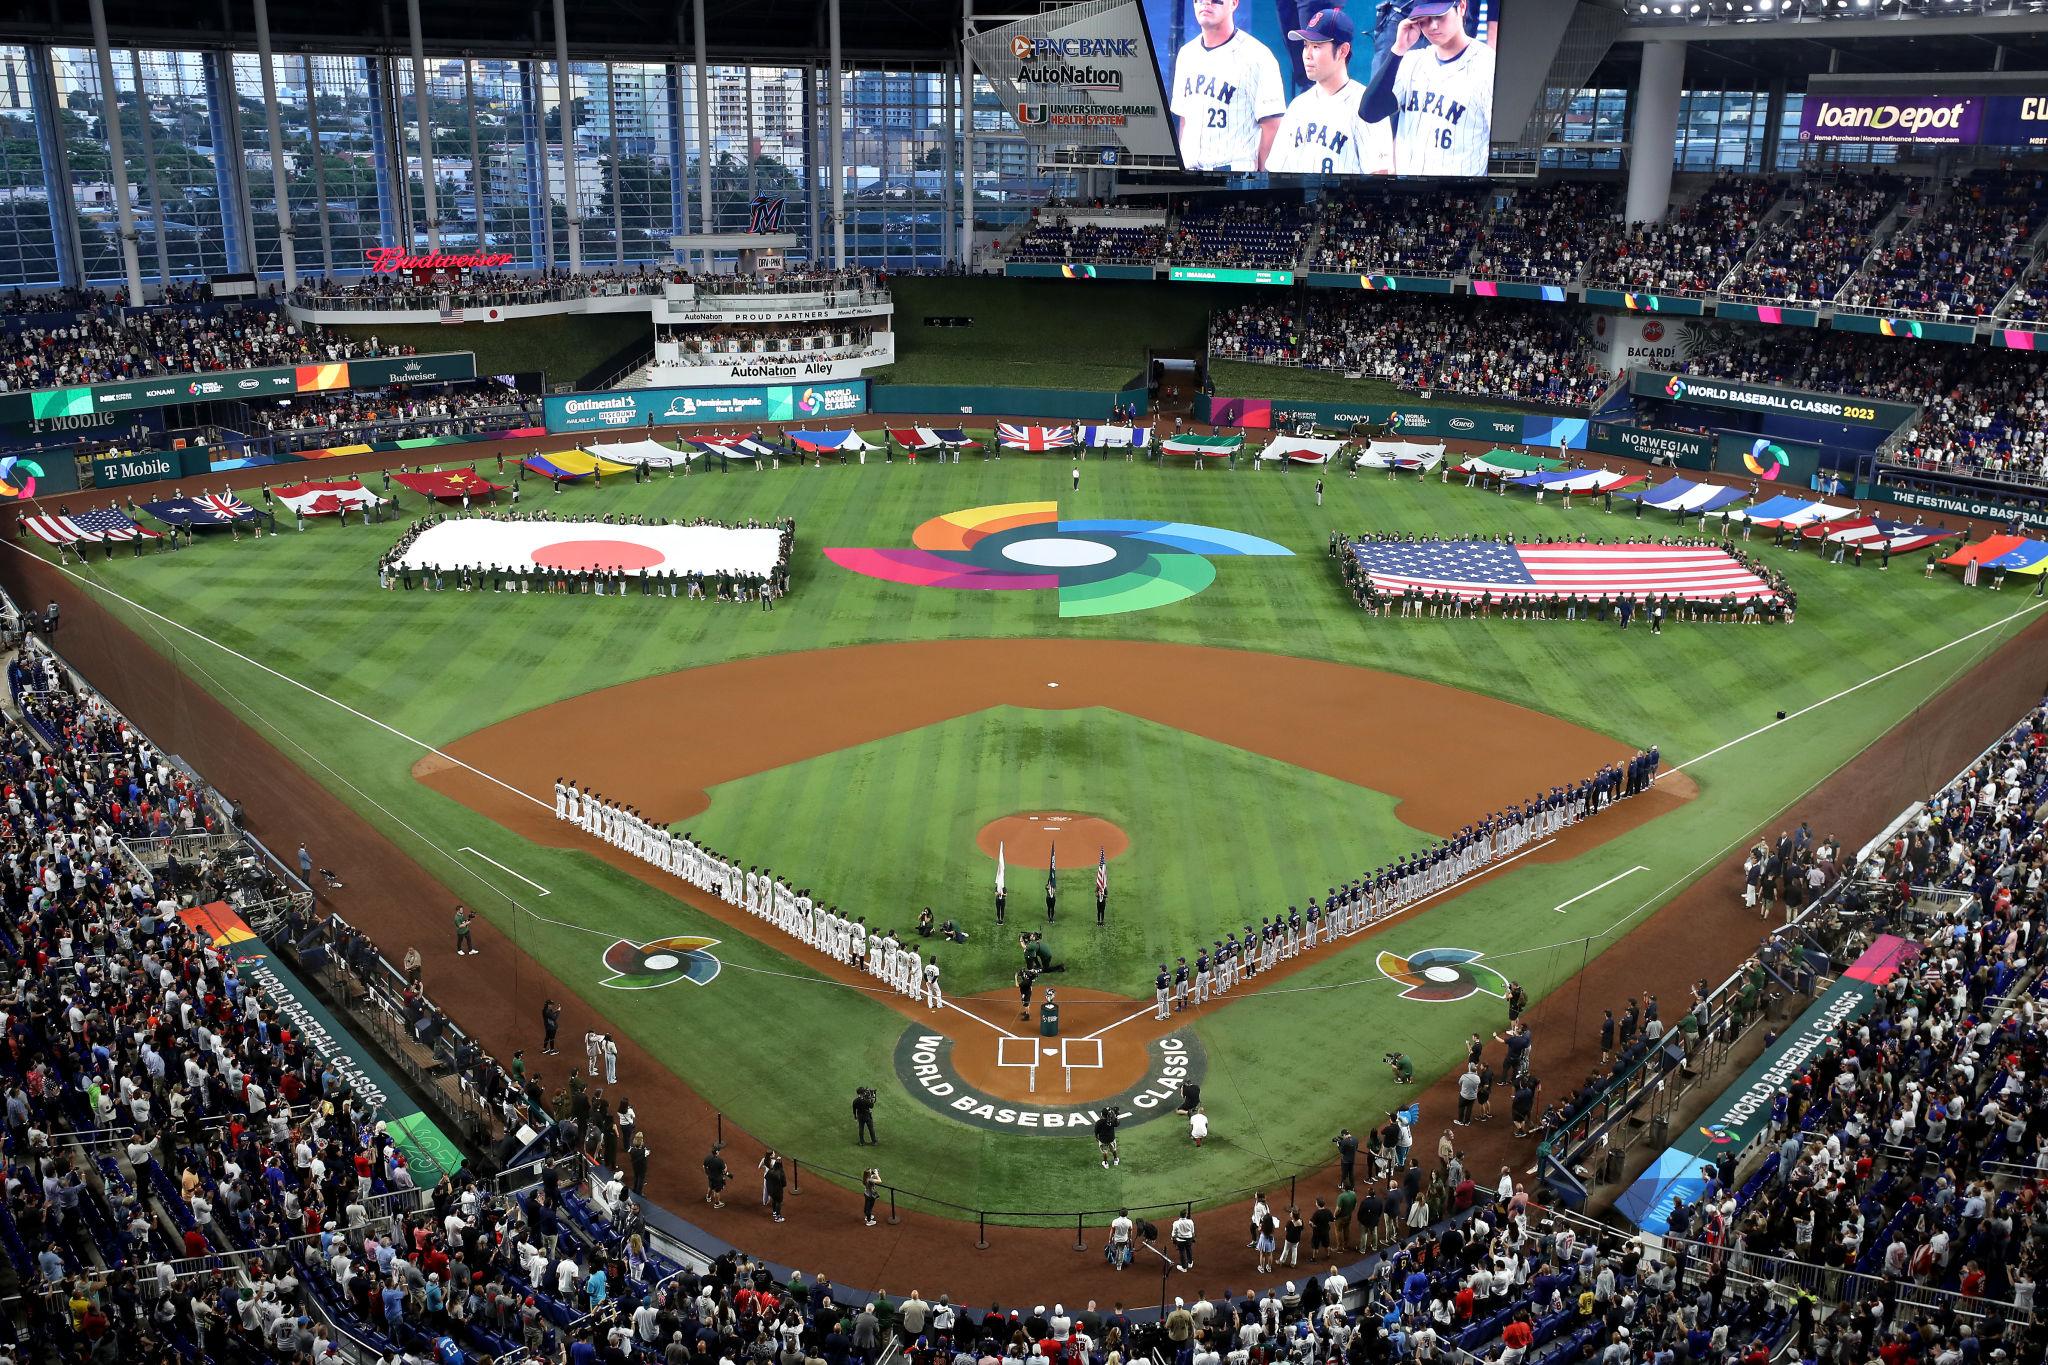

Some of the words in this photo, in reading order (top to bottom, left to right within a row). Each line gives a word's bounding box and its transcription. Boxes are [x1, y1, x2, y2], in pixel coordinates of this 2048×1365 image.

[1017, 66, 1121, 84] AutoNation
[1050, 105, 1107, 115] UNIVERSITY
[1122, 105, 1156, 115] MIAMI
[1051, 115, 1086, 125] HEALTH
[1087, 115, 1125, 125] SYSTEM
[1207, 107, 1227, 129] 23
[1816, 102, 1965, 134] loanDepot
[1434, 128, 1453, 150] 16
[1103, 151, 1116, 162] 42
[366, 247, 513, 273] Budweiser
[735, 313, 772, 321] PROUD
[778, 311, 829, 320] PARTNERS
[1627, 345, 1675, 358] BACARDÍ
[389, 371, 437, 383] Budweiser
[731, 364, 796, 378] AutoNation
[805, 363, 833, 376] Alley
[146, 388, 175, 397] KONAMI
[825, 388, 851, 398] WORLD
[825, 394, 861, 404] BASEBALL
[1420, 391, 1432, 400] 387
[565, 396, 625, 414] Continental
[696, 399, 731, 407] Dominican
[732, 398, 762, 406] Republic
[825, 402, 856, 411] CLASSIC
[1687, 384, 1728, 401] WORLD
[1729, 390, 1789, 409] BASEBALL
[1790, 399, 1842, 416] CLASSIC
[1843, 405, 1875, 420] 2023
[960, 406, 973, 414] 400
[1493, 422, 1515, 432] THK
[1621, 432, 1699, 454] NORWEGIAN
[1634, 445, 1663, 458] CRUISE
[121, 459, 171, 478] Mobile
[1893, 491, 1915, 504] THE
[1916, 495, 1970, 513] FESTIVAL
[1971, 504, 1988, 515] OF
[251, 967, 296, 1010] WORLD
[284, 1001, 342, 1057] BASEBALL
[331, 1056, 387, 1105] CLASSIC
[1720, 1082, 1775, 1126] WORLD
[1762, 1030, 1826, 1086] BASEBALL
[1813, 990, 1864, 1032] CLASSIC
[911, 1035, 954, 1097] WORLD
[1133, 1037, 1189, 1109] CLASSIC
[445, 1340, 459, 1357] 13
